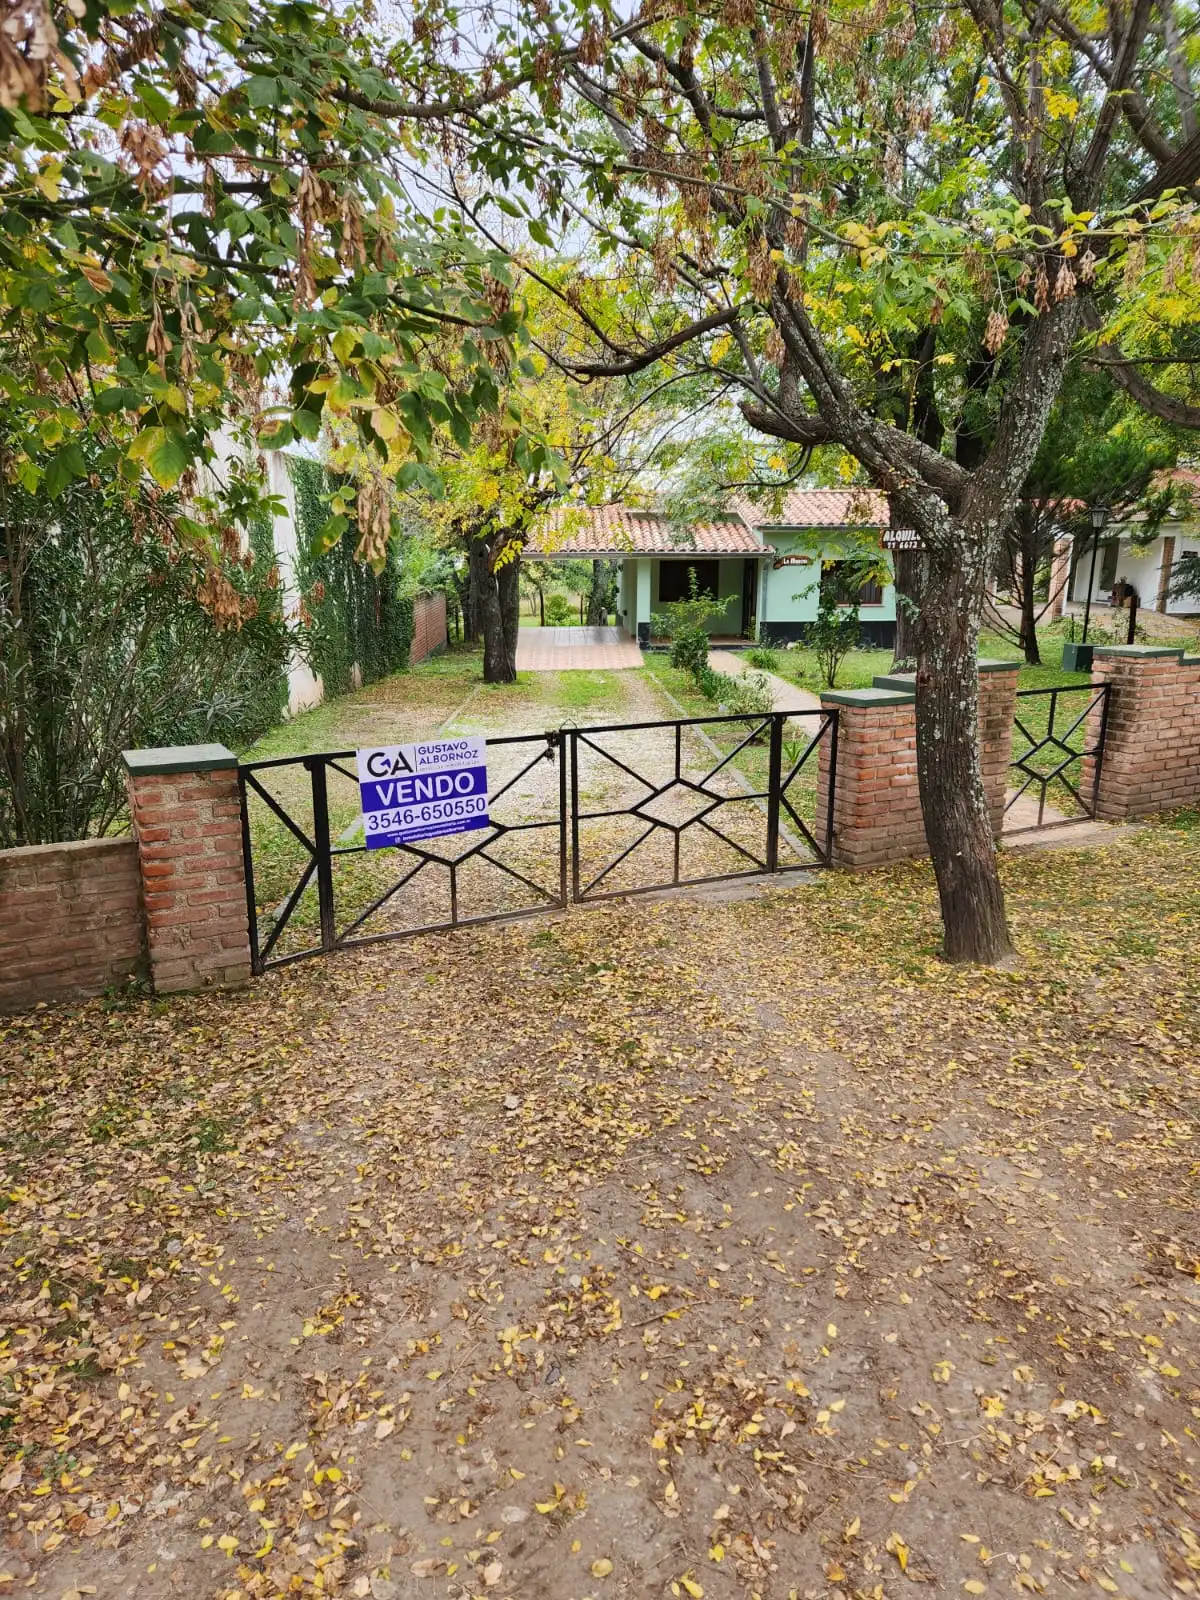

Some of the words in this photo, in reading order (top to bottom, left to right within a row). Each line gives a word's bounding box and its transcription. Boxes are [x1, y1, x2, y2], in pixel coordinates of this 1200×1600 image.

[418, 741, 468, 755] GUSTAVO
[419, 749, 479, 765] ALBORNOZ
[375, 772, 475, 806] VENDO
[368, 797, 485, 831] 3546-650550
